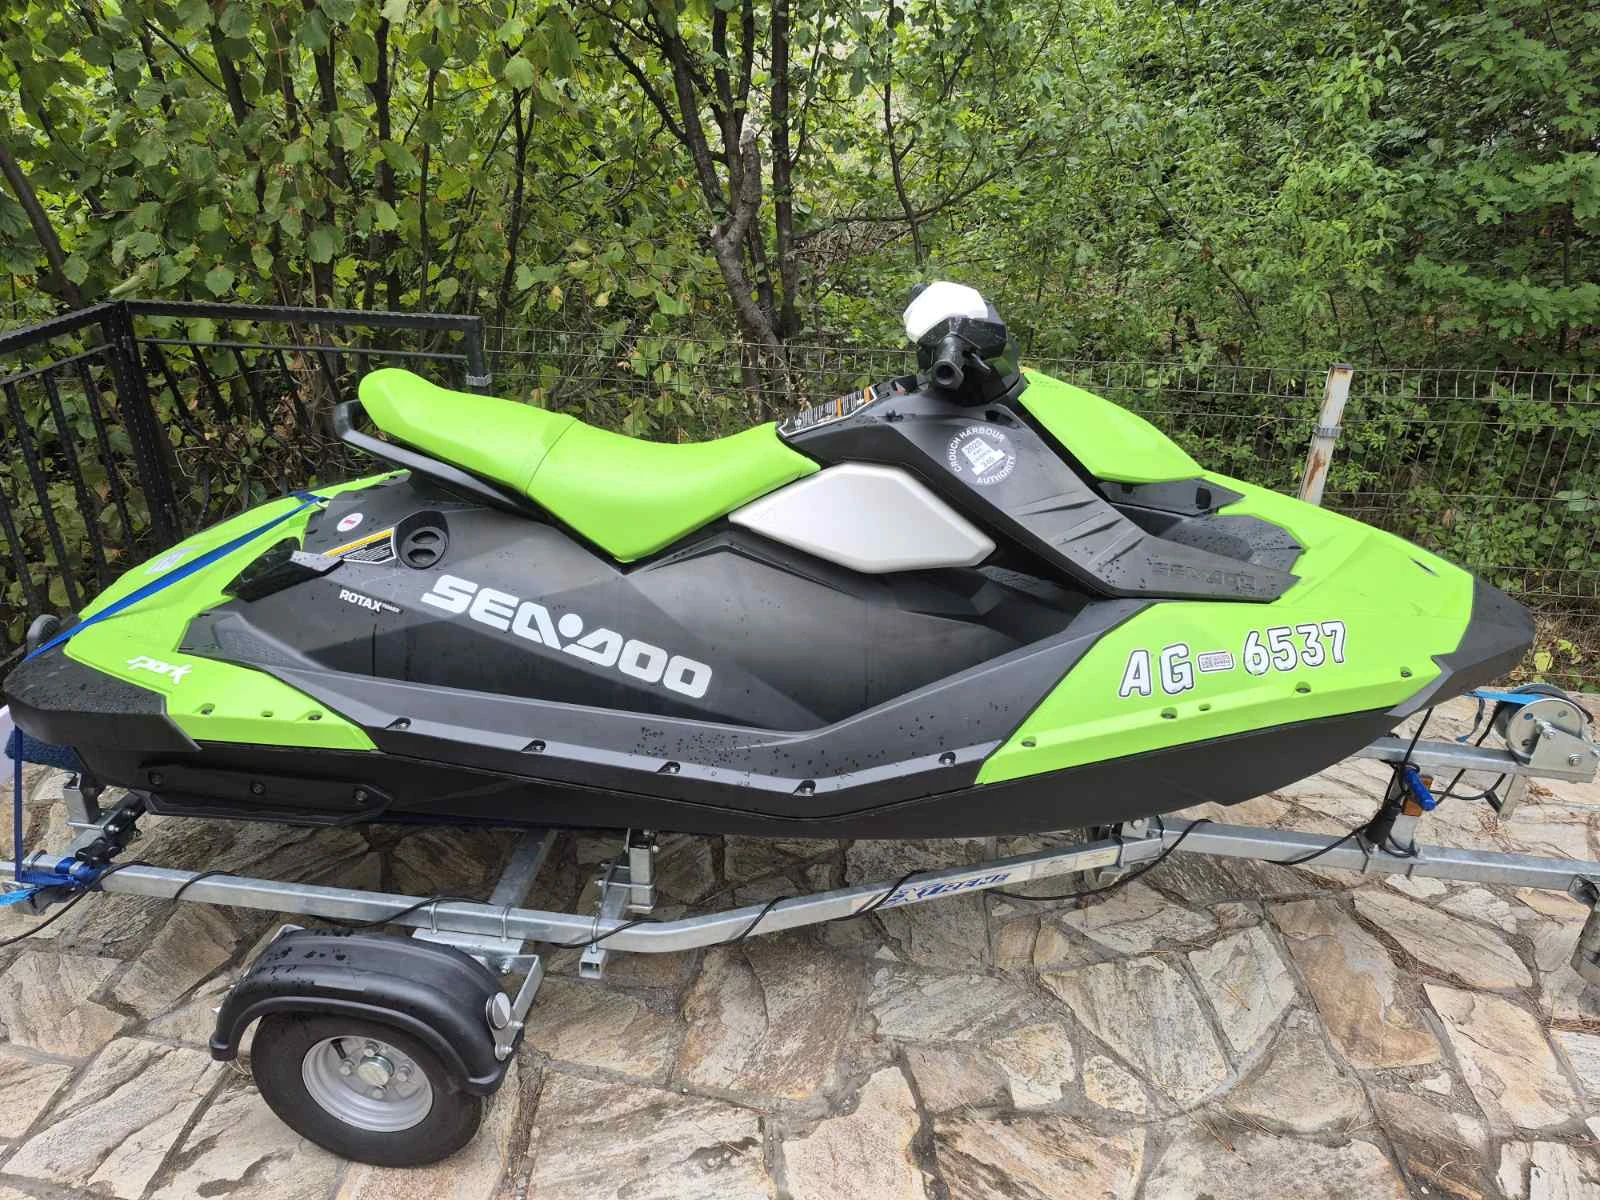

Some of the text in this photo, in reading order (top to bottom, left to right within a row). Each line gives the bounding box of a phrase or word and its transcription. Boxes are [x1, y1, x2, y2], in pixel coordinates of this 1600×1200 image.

[948, 437, 962, 473] CROUCH
[960, 426, 1006, 441] HARBOUR
[976, 455, 1016, 485] AUTHORITY
[339, 589, 382, 612] ROTAX
[1243, 620, 1346, 676] 6537
